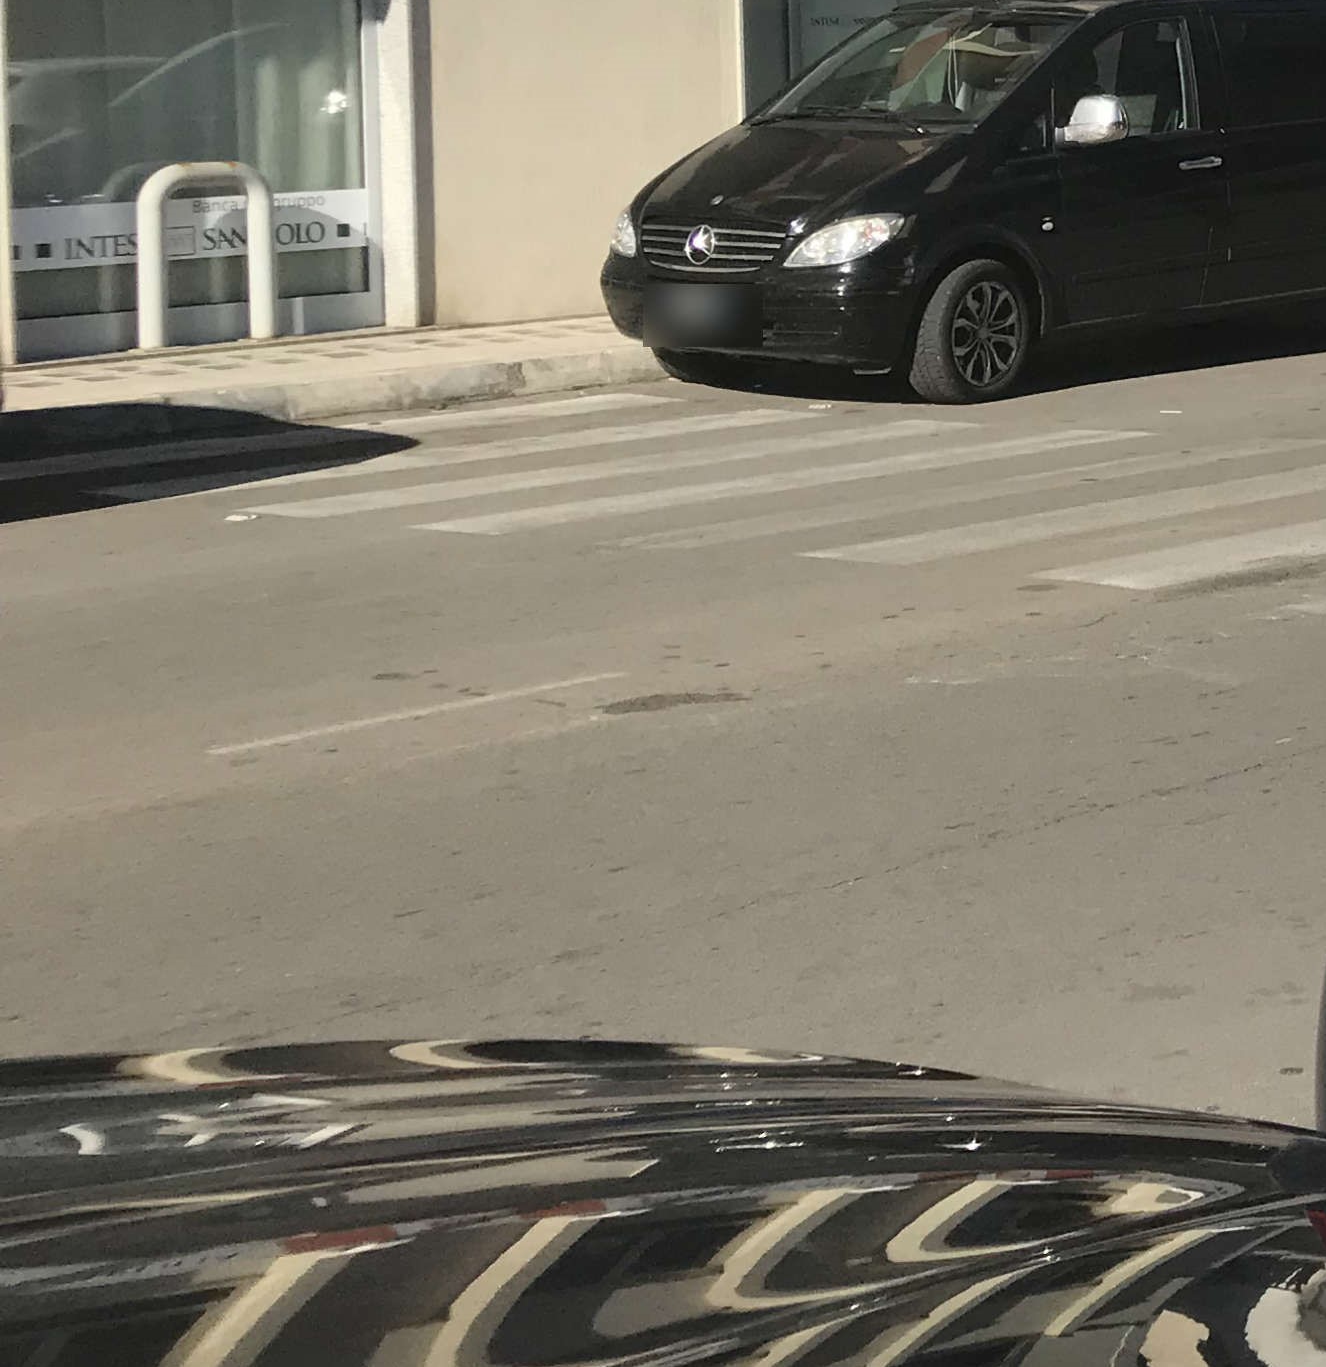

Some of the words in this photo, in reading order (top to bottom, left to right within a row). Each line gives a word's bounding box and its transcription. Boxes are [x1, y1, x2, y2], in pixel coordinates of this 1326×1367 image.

[193, 199, 239, 214] Banca
[64, 234, 139, 260] INTES
[203, 221, 326, 251] SANOLO
